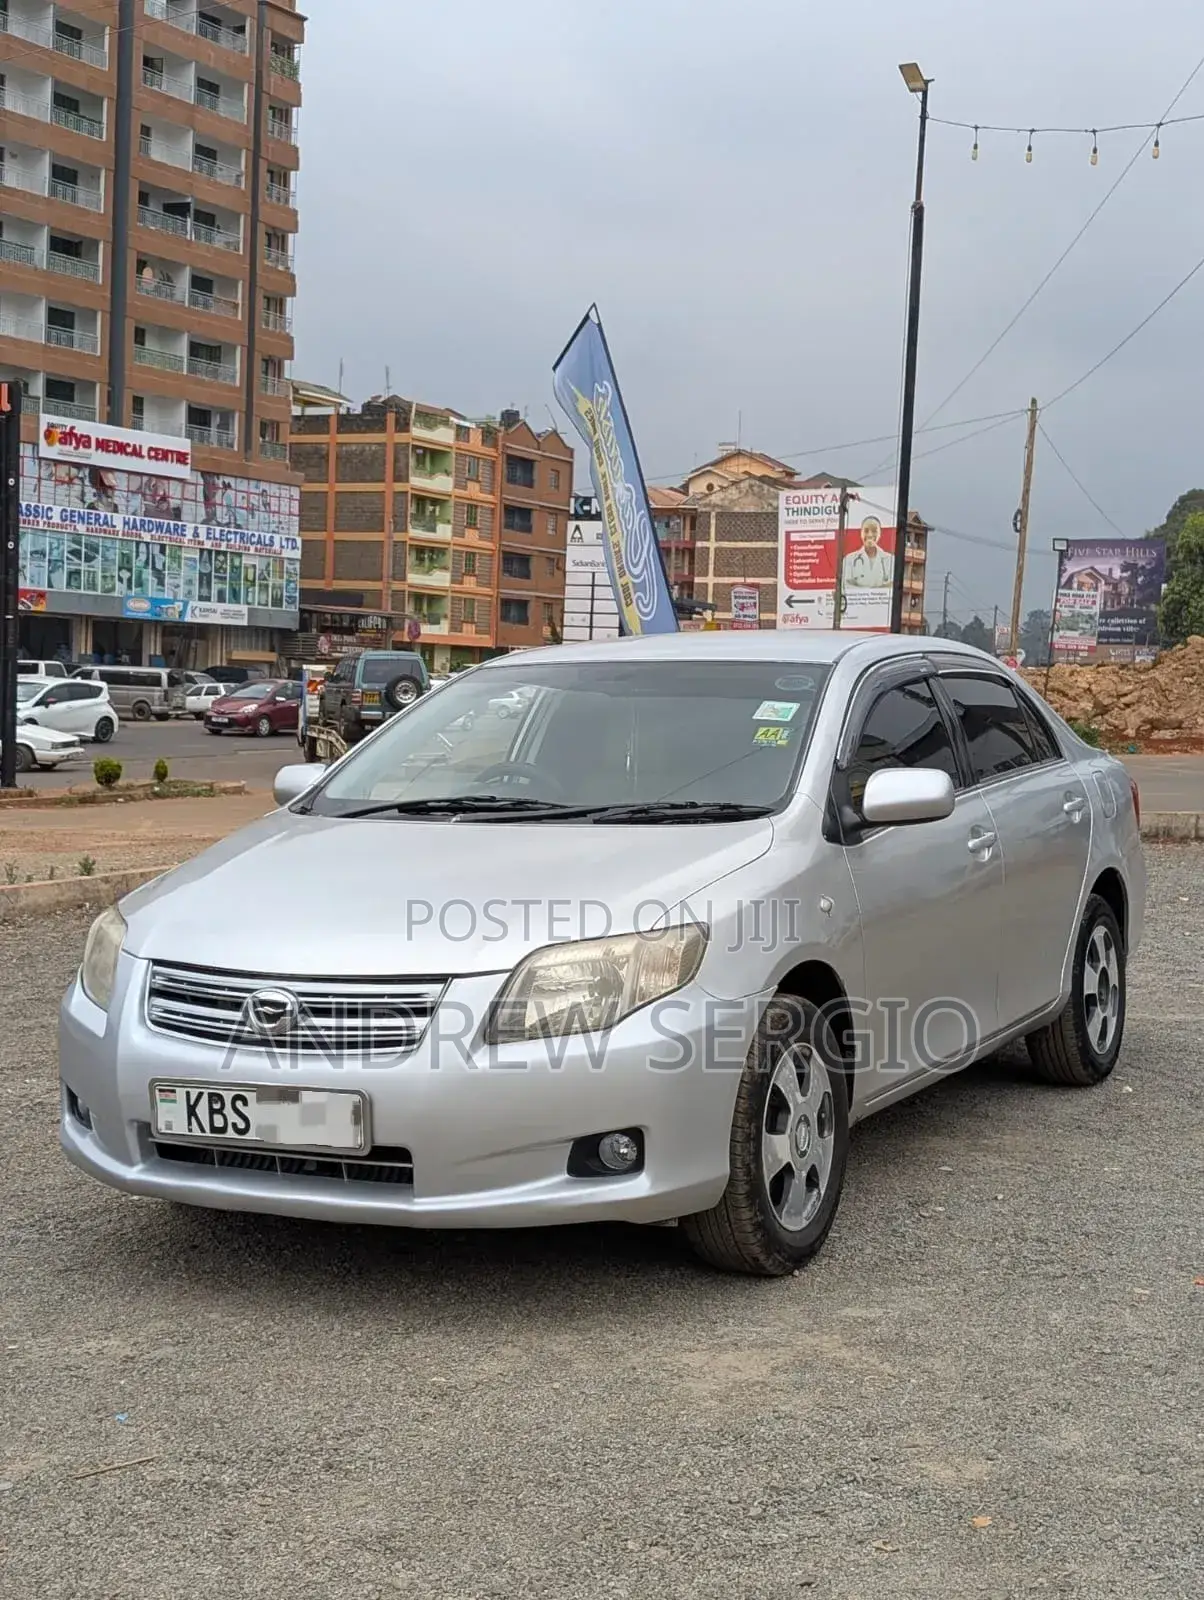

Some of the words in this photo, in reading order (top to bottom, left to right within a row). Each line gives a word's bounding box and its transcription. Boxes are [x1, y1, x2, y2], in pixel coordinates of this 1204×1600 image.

[58, 425, 91, 451] afya
[95, 437, 145, 459] MEDICAL
[147, 446, 189, 465] CENTRE
[785, 494, 828, 505] EQUITY
[785, 506, 841, 517] THINDIGU
[60, 508, 116, 528] GENERAL
[122, 516, 187, 537] HARDWARE
[192, 526, 200, 538] &
[206, 527, 275, 547] ELECTRICALS
[280, 537, 299, 551] LTD.
[184, 1089, 251, 1136] KBS
